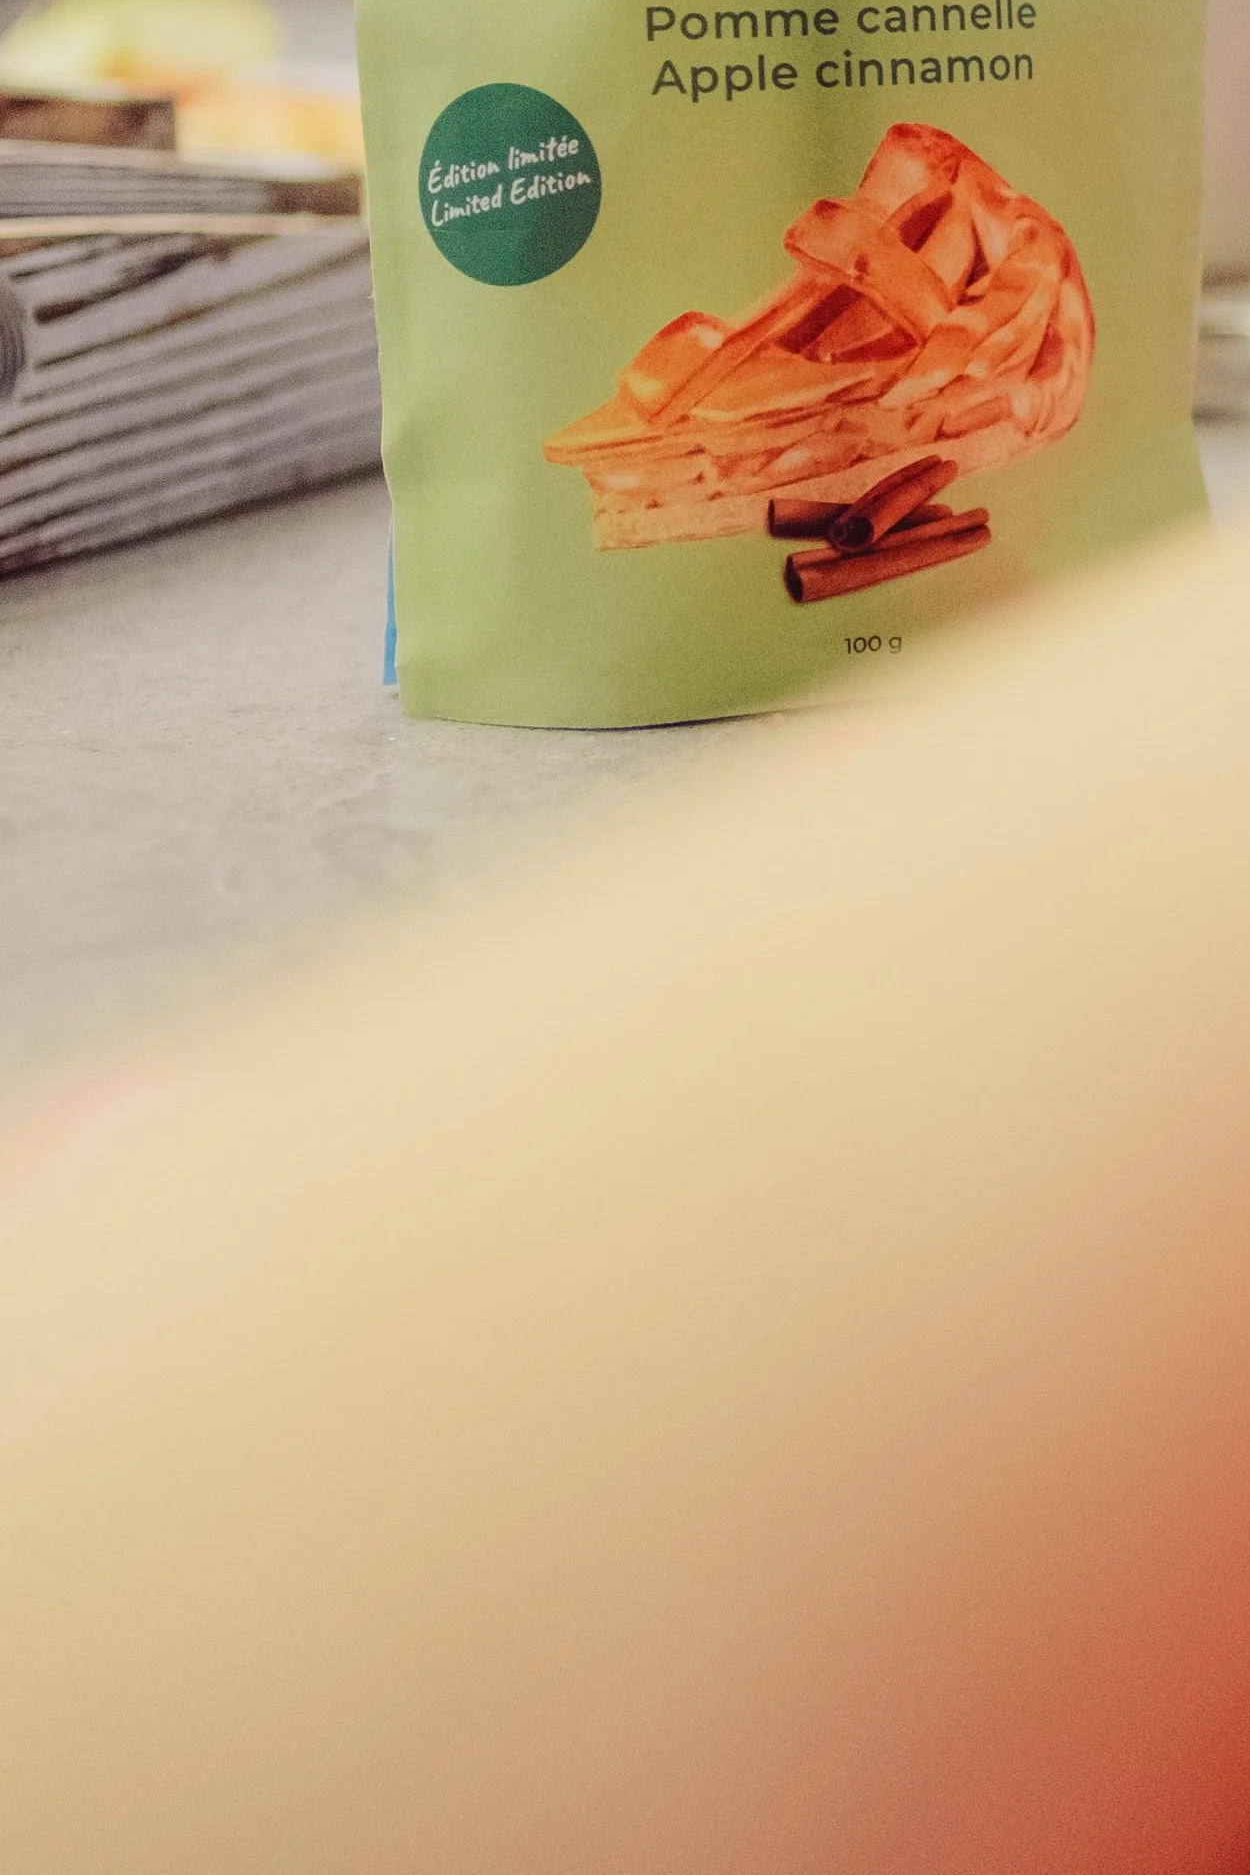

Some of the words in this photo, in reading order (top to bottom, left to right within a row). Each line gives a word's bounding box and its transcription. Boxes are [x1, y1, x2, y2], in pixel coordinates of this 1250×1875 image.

[646, 4, 839, 43] Pomme
[651, 54, 798, 104] Apple
[815, 48, 1034, 90] cinnamon
[427, 160, 500, 194] Édition
[507, 135, 579, 171] limitée
[431, 183, 503, 227] Limited
[510, 170, 592, 205] Edition
[844, 635, 882, 655] 100
[888, 636, 902, 654] g
